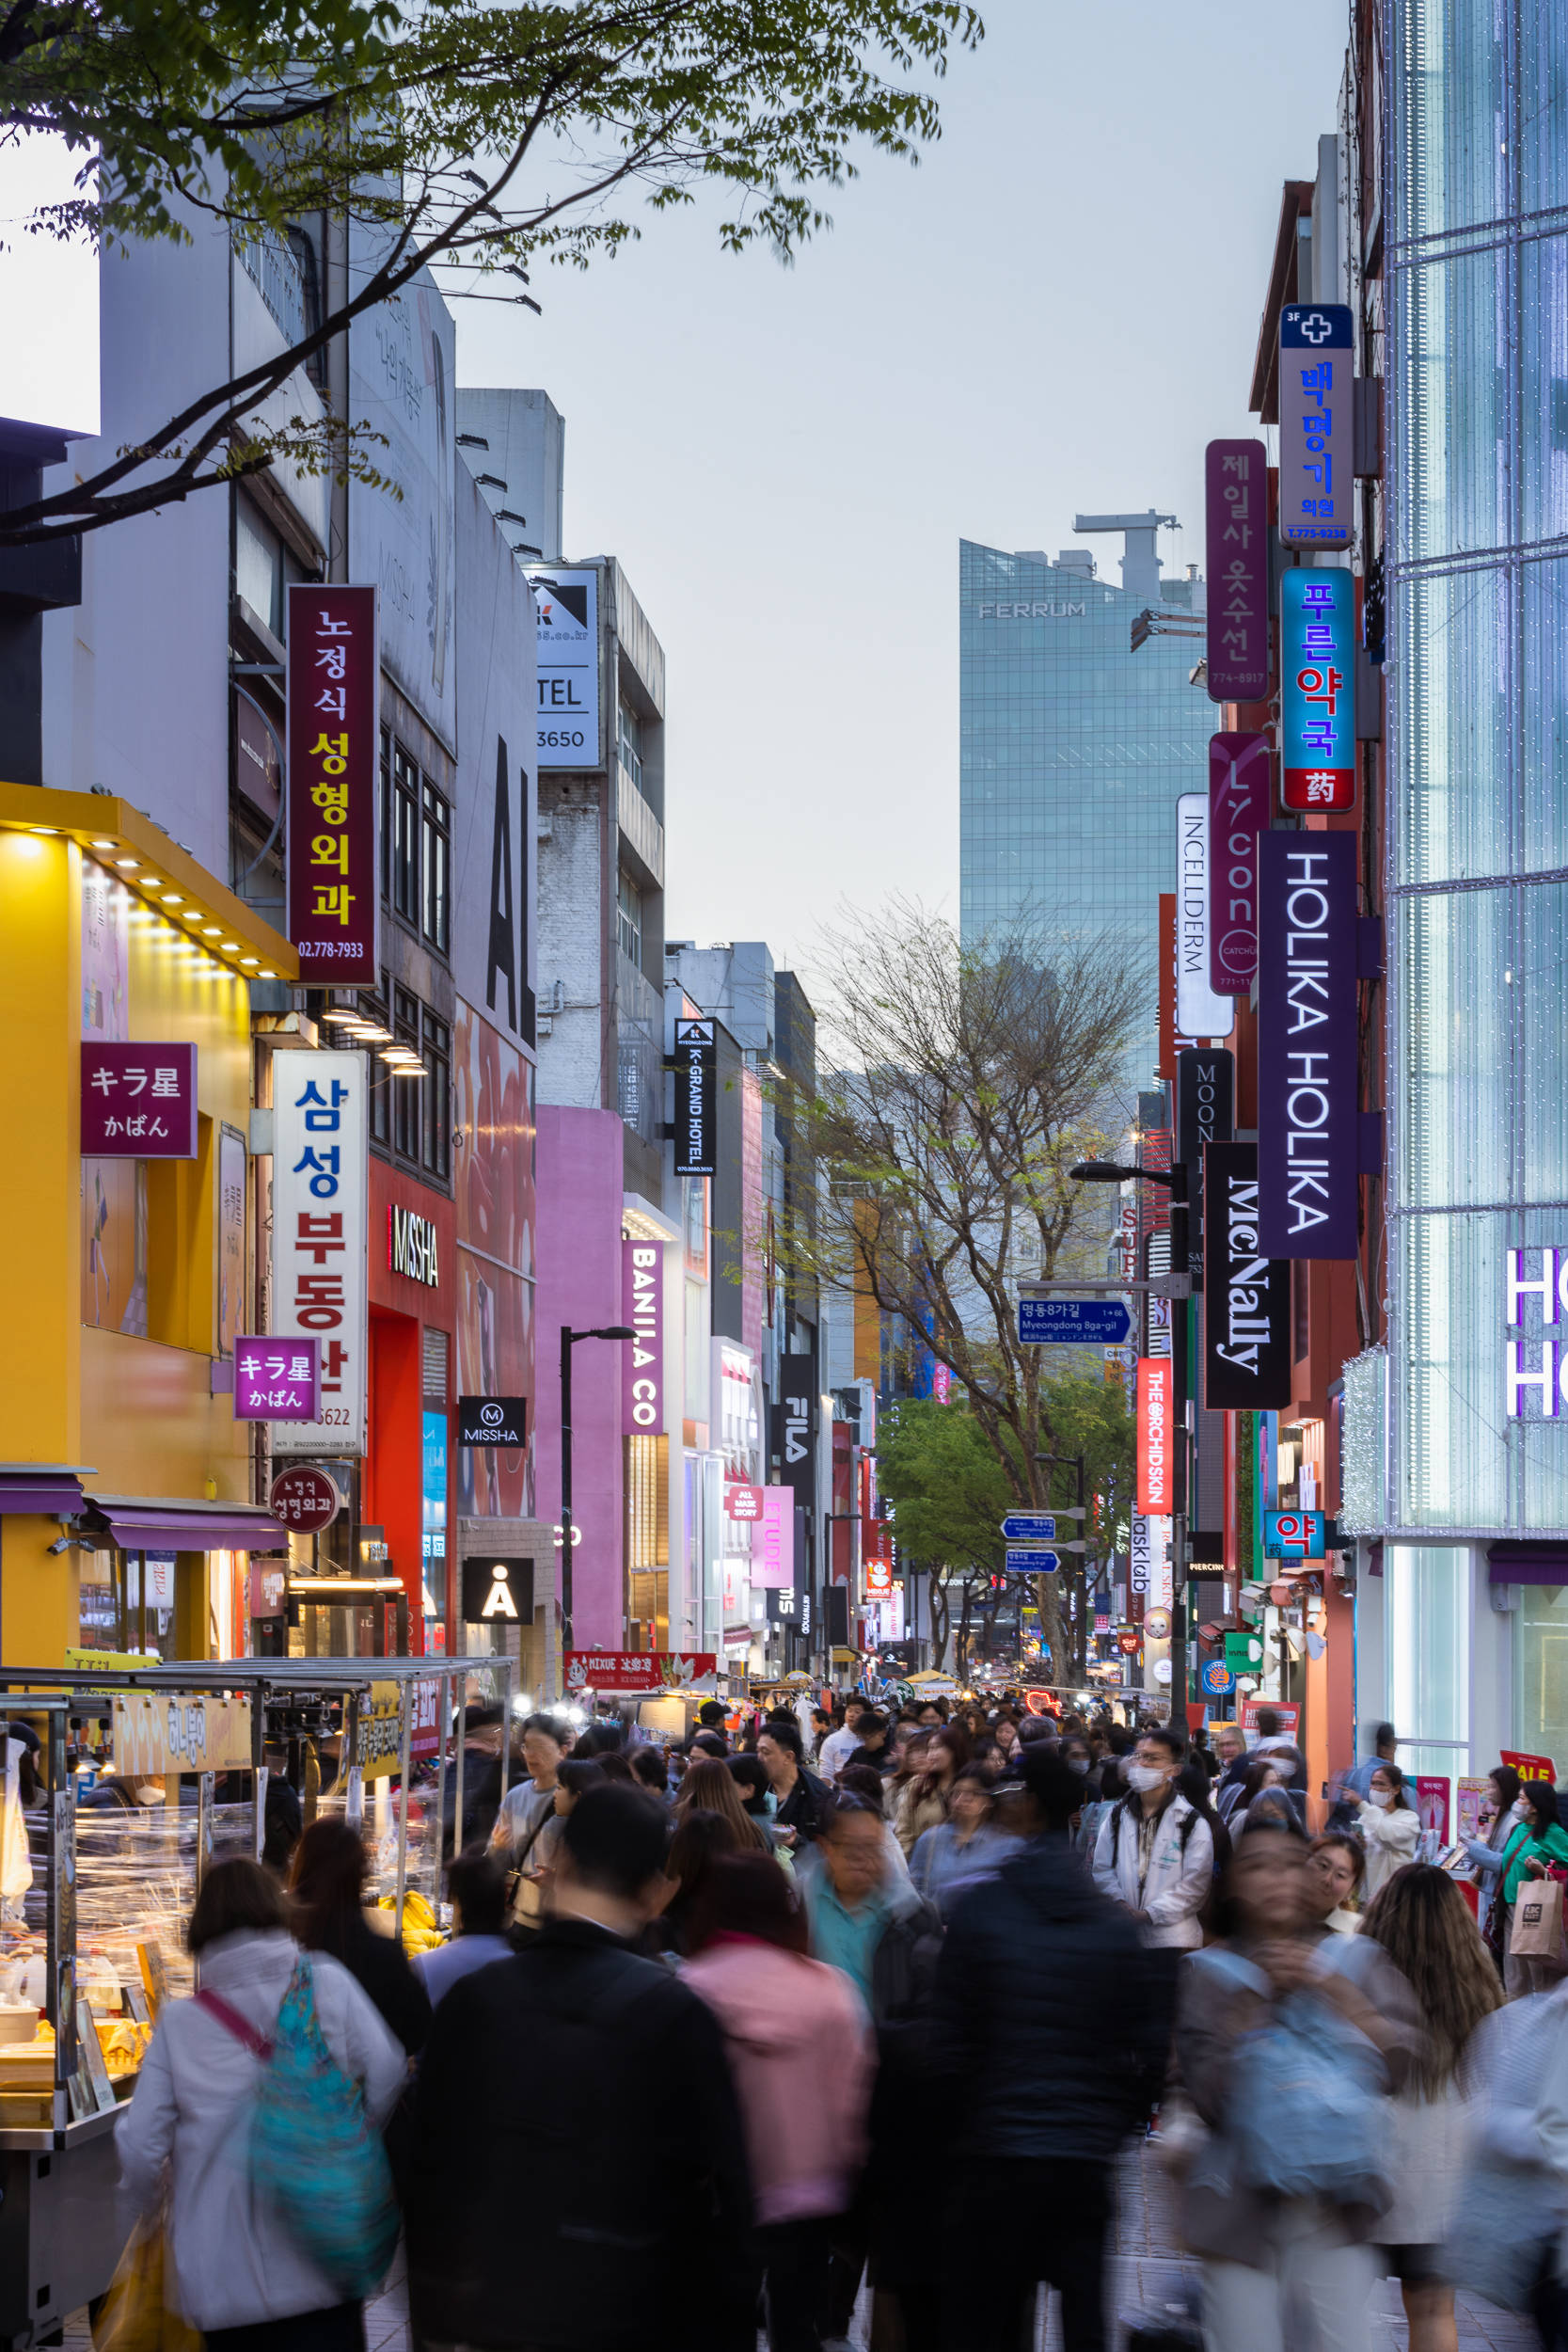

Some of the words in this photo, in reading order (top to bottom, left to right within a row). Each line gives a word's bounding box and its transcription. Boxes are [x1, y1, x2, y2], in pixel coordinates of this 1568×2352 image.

[1288, 312, 1300, 322] 3F
[1222, 455, 1253, 549] 제일사
[1302, 500, 1334, 517] 의원
[978, 601, 1087, 619] FERRUM
[1222, 560, 1254, 661] 옷수선
[314, 611, 353, 722] 노정식
[1306, 772, 1336, 803] 药
[309, 733, 356, 926] 성형외과
[1184, 816, 1205, 974] INCELLDERM
[298, 941, 364, 959] 02.778-7933
[1287, 853, 1329, 1035] HOLIKA
[91, 1068, 181, 1098] キラ星
[689, 1048, 703, 1116] K-GRAND
[104, 1116, 168, 1137] かばん
[689, 1120, 703, 1164] HOTEL
[1287, 1053, 1329, 1234] HOLIKA
[391, 1205, 438, 1288] MISSHA
[1216, 1176, 1270, 1375] McNally
[1507, 1248, 1568, 1325] H
[632, 1248, 657, 1368] BANILA
[1022, 1304, 1080, 1317] 명동8가길
[1022, 1321, 1082, 1331] Myeongdong
[1085, 1321, 1117, 1331] 8ga-gil
[239, 1355, 312, 1382] キラ星
[1507, 1341, 1568, 1416] H
[249, 1390, 302, 1407] かばん
[632, 1378, 657, 1426] CO
[465, 1429, 518, 1442] MISSHA
[785, 1397, 808, 1463] FILA
[276, 1498, 331, 1519] 성형외과
[765, 1502, 781, 1571] ETUDE
[1276, 1515, 1316, 1556] 약
[589, 1658, 616, 1670] MIXUE
[1507, 1763, 1550, 1781] ALE
